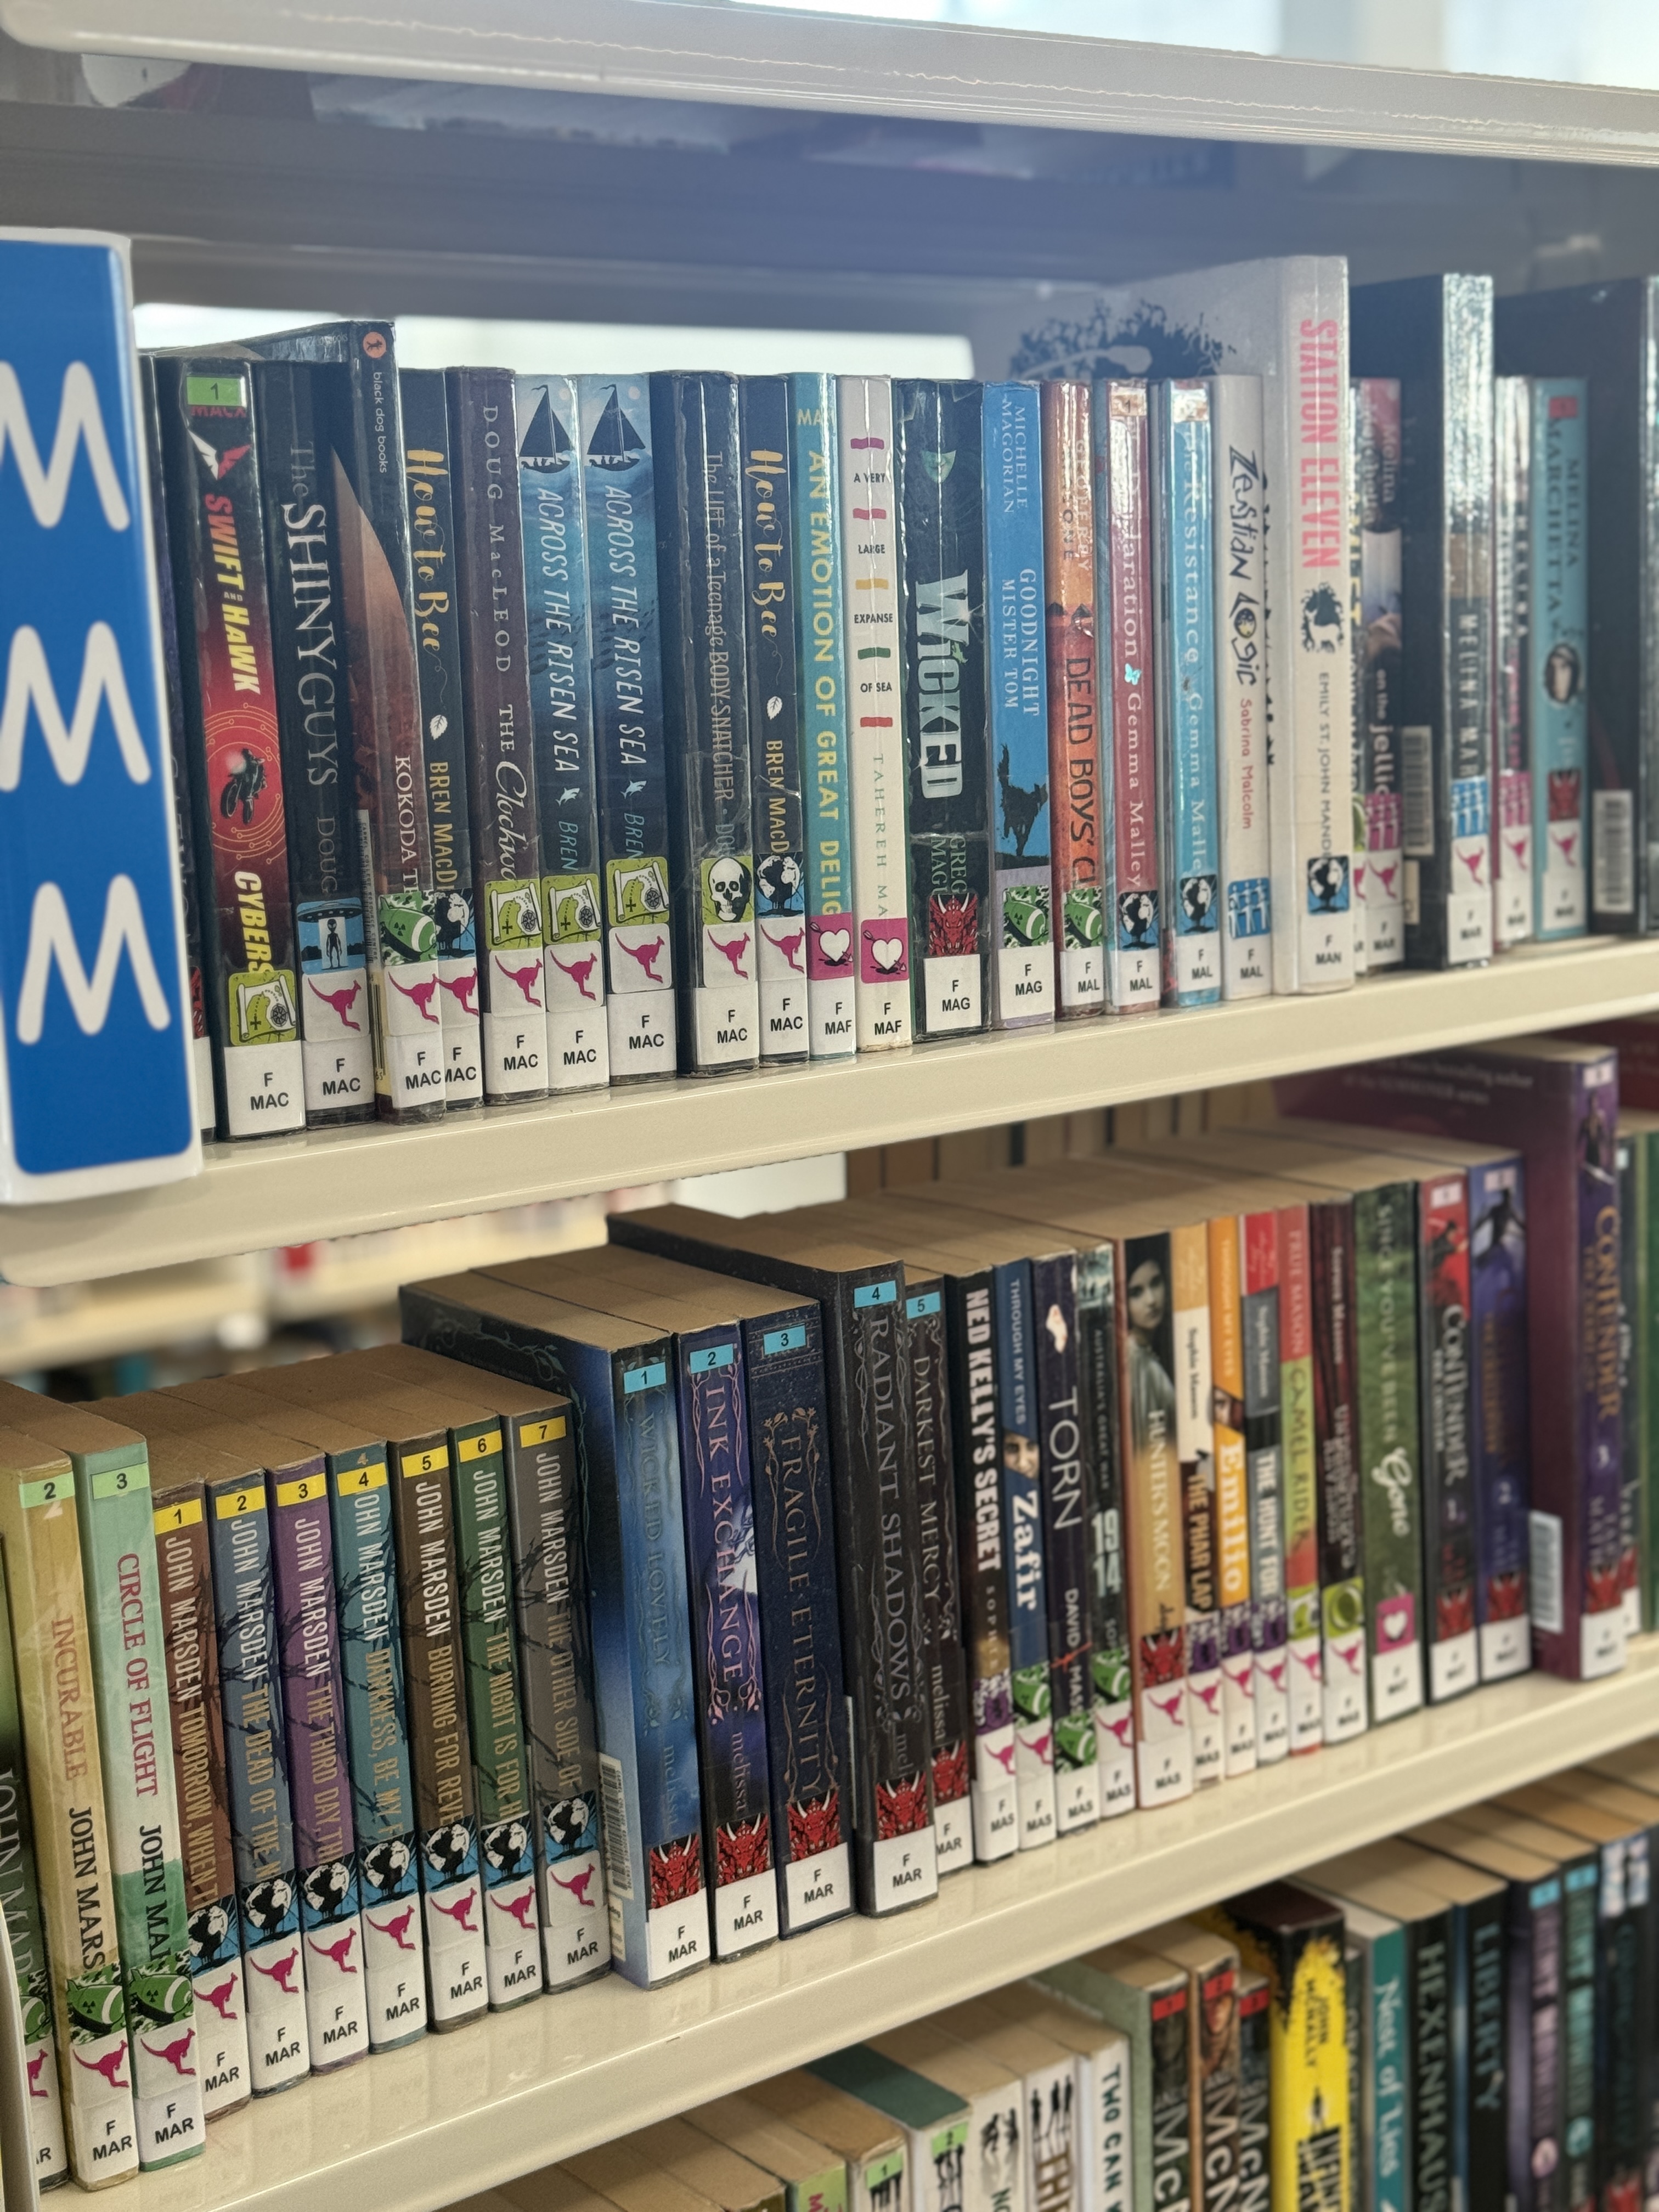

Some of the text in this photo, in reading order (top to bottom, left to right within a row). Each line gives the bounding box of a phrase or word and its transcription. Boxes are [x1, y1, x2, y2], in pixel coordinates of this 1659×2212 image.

[211, 383, 218, 400] 1
[373, 372, 387, 473] black dog books
[0, 360, 129, 531] M
[854, 473, 885, 483] A VERY
[1001, 400, 1014, 514] MAGORIAN
[1015, 407, 1028, 509] MICHELLE
[1300, 319, 1340, 568] STATION ELEVEN
[406, 448, 449, 652] How to Bee
[483, 406, 511, 672] DOUG MacLEOD
[706, 533, 726, 552] of
[858, 544, 885, 554] LARGE
[205, 493, 261, 695] SWIFT AND HAWK
[538, 488, 579, 771] ACROSS THE RISEN SEA
[706, 571, 727, 646] Teenage
[809, 450, 838, 820] AN EMOTION OF GREAT
[854, 614, 893, 624] EXPANSE
[1002, 579, 1018, 708] MISTER TOM
[1019, 568, 1039, 715] GOODNIGHT
[0, 622, 151, 791] M
[281, 442, 338, 894] The SHINY GUYS DOUG
[861, 681, 892, 693] OF SEA
[916, 569, 969, 798] WICKED
[1319, 673, 1329, 718] EMILY
[500, 704, 514, 752] THE
[708, 651, 734, 802] BODY-SNATCHER
[1066, 658, 1094, 845] DEAD BOYS'
[1240, 699, 1253, 829] Sabrina Malcolm
[1318, 748, 1330, 793] JOHN
[395, 755, 417, 863] KOKODA
[430, 762, 452, 814] BREN
[873, 754, 887, 867] TAHEREH
[1127, 692, 1145, 886] Gemma Malley
[558, 821, 579, 871] BREN
[17, 873, 171, 1045] M
[1015, 980, 1042, 996] MAG
[1025, 963, 1031, 977] F
[1316, 953, 1341, 964] MAN
[1325, 935, 1331, 946] F
[874, 1020, 902, 1035] MAF
[884, 1002, 891, 1015] F
[323, 1077, 360, 1096] MAC
[336, 1058, 345, 1073] F
[781, 1333, 789, 1347] 3
[872, 1288, 880, 1300] 4
[917, 1299, 925, 1312] 5
[641, 1371, 648, 1384] 1
[708, 1352, 716, 1365] 2
[1010, 1278, 1026, 1425] THROUGH MY EYES
[359, 1472, 369, 1487] 4
[422, 1455, 431, 1471] 5
[477, 1438, 487, 1453] 6
[539, 1425, 548, 1439] 7
[914, 1356, 940, 1602] DARKEST MERCY
[967, 1288, 1002, 1572] NED KELLY'S SECRET
[1049, 1386, 1082, 1530] TORN
[44, 1482, 55, 1500] 2
[116, 1474, 127, 1489] 3
[173, 1509, 183, 1524] 1
[237, 1495, 247, 1511] 2
[298, 1483, 308, 1498] 3
[537, 1453, 569, 1604] JOHN MARSDEN
[869, 1317, 910, 1700] RADIANT SHADOWS
[416, 1482, 451, 1638] JOHN MARSDEN
[473, 1470, 507, 1624] JOHN MARSDEN
[640, 1414, 669, 1665] WICKED LOVELY
[706, 1387, 743, 1681] INK EXCHANGE
[1012, 1491, 1041, 1610] Zafir
[1189, 1513, 1212, 1614] PHAR LAP
[165, 1537, 202, 1702] JOHN MARSDEN
[232, 1519, 269, 1681] JOHN MARSDEN
[295, 1519, 331, 1678] JOHN MARSDEN
[357, 1543, 389, 1641] MARSDEN
[782, 1435, 823, 1798] FRAGILE ETERNITY
[51, 1615, 98, 1878] INCURABLE JOHN
[118, 1553, 167, 1897] CIRCLE OF FLIGHT JOHN
[428, 1644, 460, 1774] BURNING FOR
[486, 1628, 521, 1797] THE NIGHT IS FOR
[548, 1612, 582, 1788] THE OTHER SIDE OF
[932, 1664, 947, 1740] melissa
[242, 1683, 280, 1859] THE DEAD OF THE
[307, 1681, 341, 1833] THE THIRD DAY,
[187, 1822, 217, 1888] WHEN
[893, 1868, 922, 1887] MAR
[902, 1853, 910, 1866] F
[386, 1997, 420, 2021] MAR
[397, 1983, 405, 1997] F
[1102, 2064, 1121, 2192] TWO CAN
